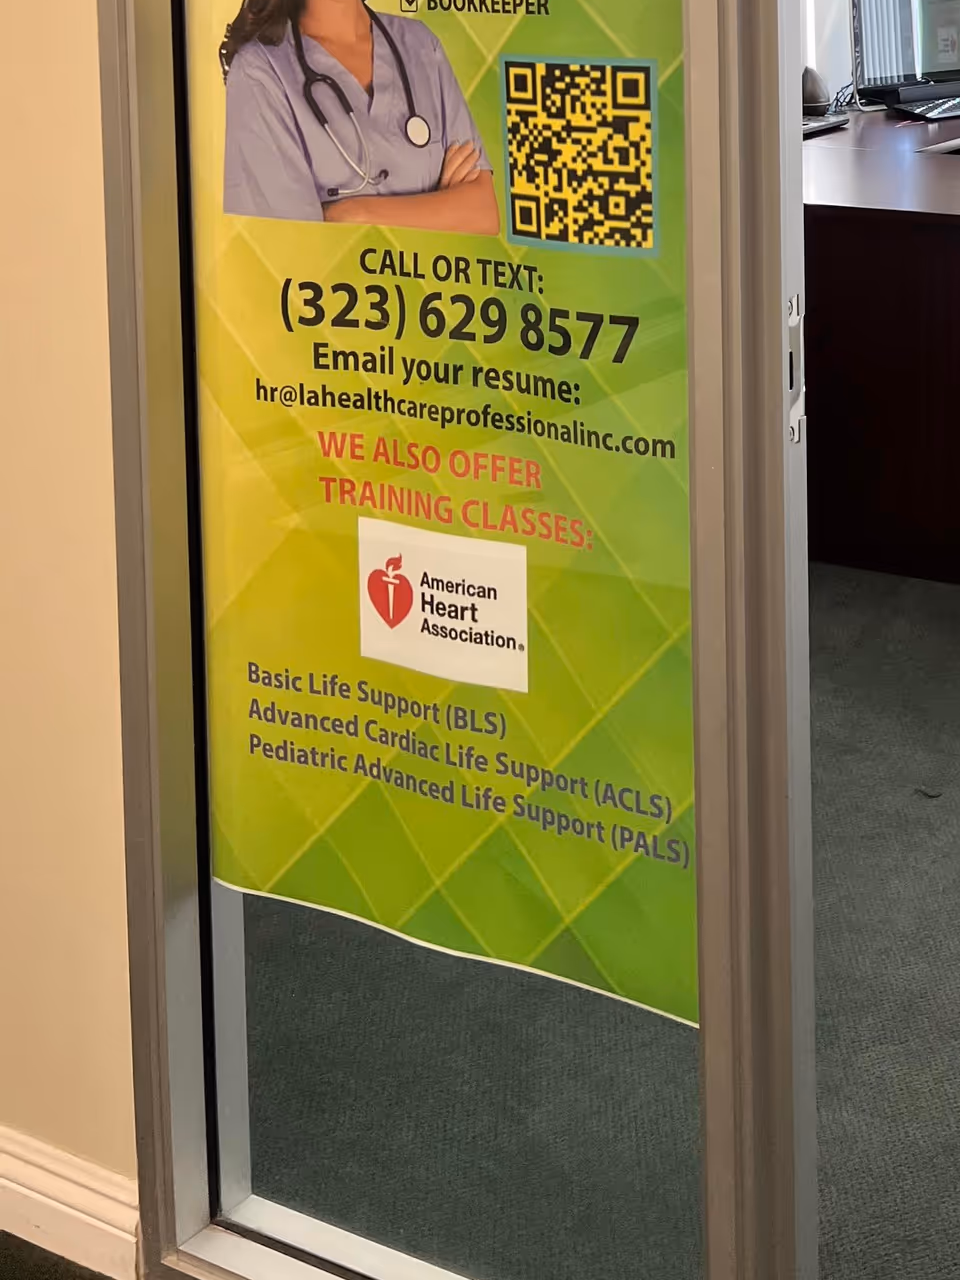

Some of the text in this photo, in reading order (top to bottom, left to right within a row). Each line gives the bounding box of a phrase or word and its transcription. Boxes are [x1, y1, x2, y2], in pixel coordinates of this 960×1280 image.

[360, 248, 544, 294] CALL OR TEXT:
[280, 278, 640, 363] (323) 629 8577
[313, 342, 581, 404] Email your resume:
[255, 378, 676, 459] hr@lahealthcareprofessionalinc.com
[318, 431, 542, 489] WE ALSO OFFER
[319, 477, 593, 550] TRAINING CLASSES:
[420, 572, 497, 600] American
[421, 593, 478, 623] Heart
[248, 662, 506, 740] Basic Life Support (BLS)
[249, 699, 673, 824] Advanced Cardiac Life Support (ACLS)
[249, 734, 690, 869] Pediatric Advanced Life Support (PALS)
